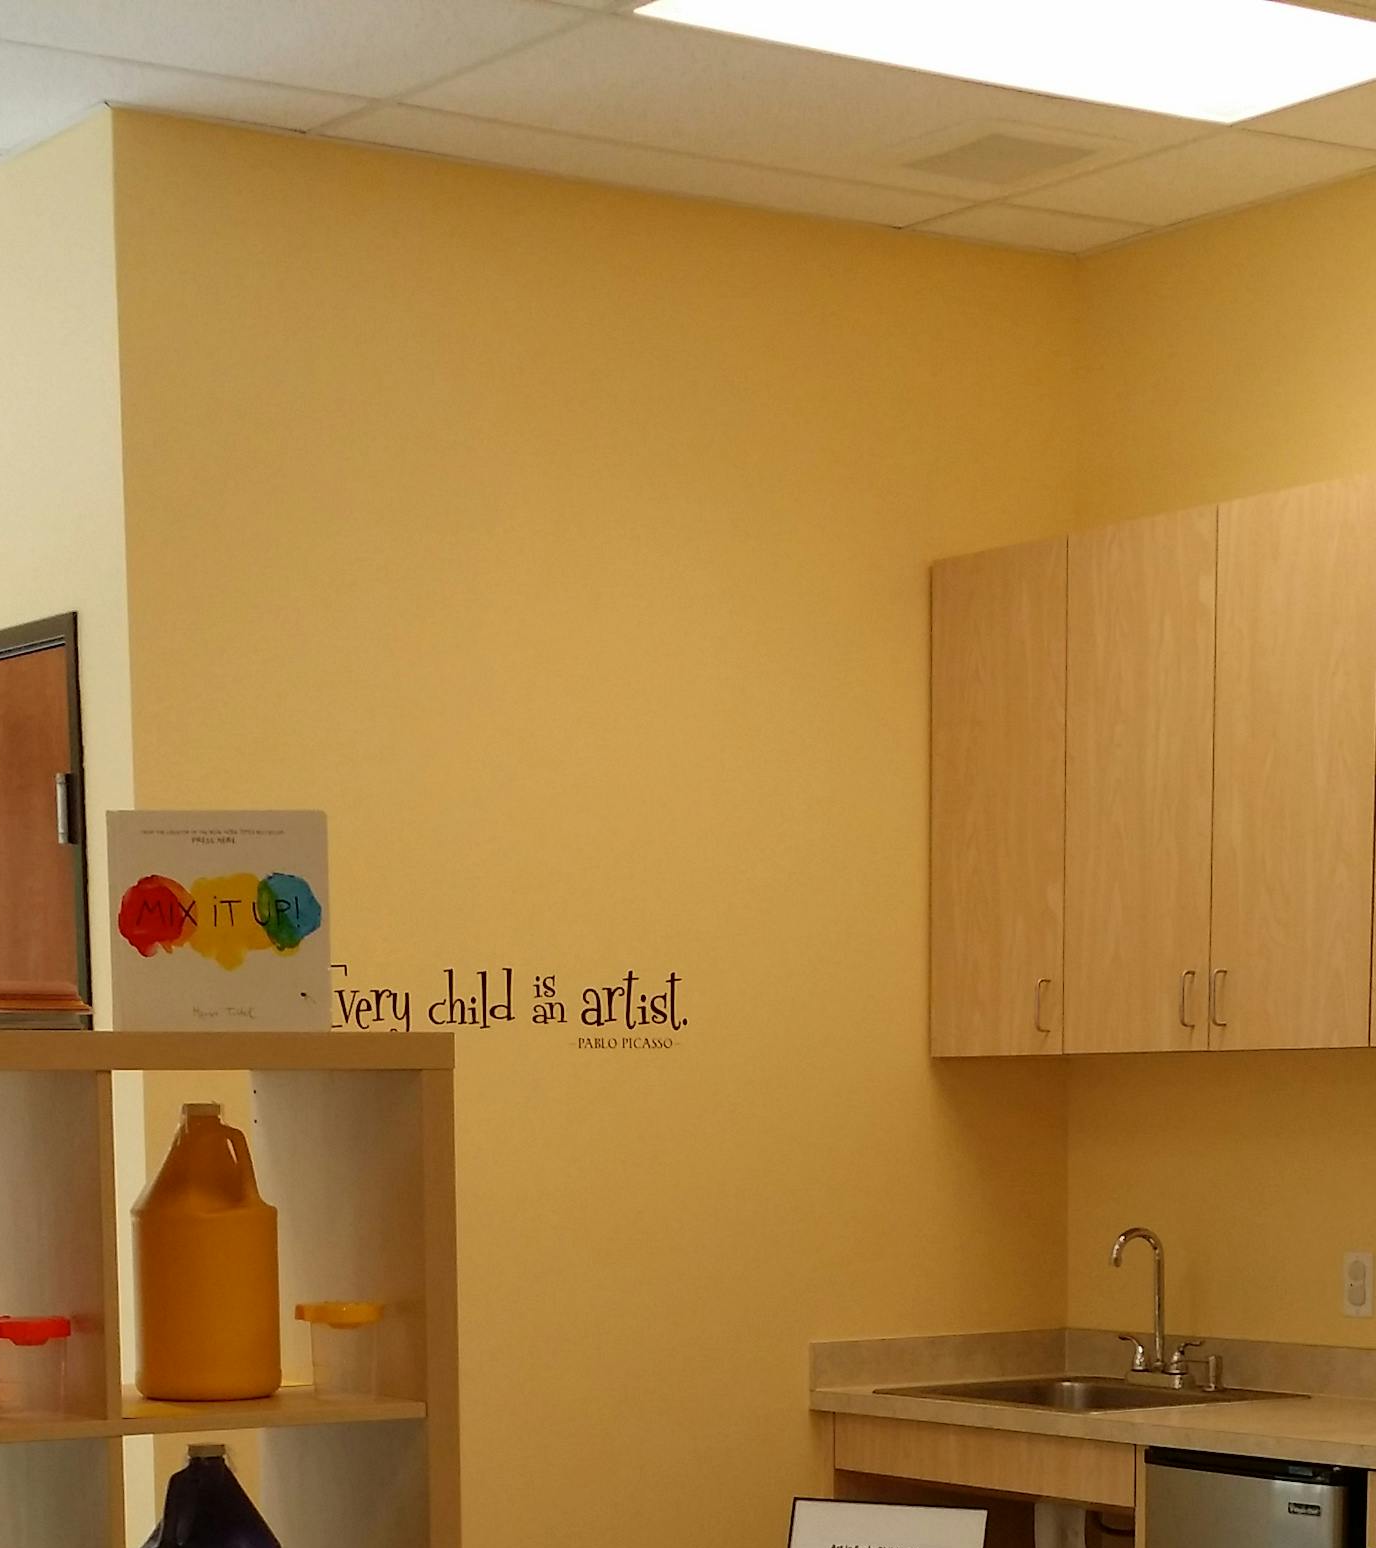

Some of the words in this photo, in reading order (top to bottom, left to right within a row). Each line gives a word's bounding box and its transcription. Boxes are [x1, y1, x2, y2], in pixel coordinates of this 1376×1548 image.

[136, 899, 198, 927] MIX
[252, 895, 301, 928] UP!
[428, 968, 516, 1029] child
[533, 975, 556, 998] is
[580, 970, 689, 1031] artist.
[531, 1001, 568, 1025] an
[578, 1037, 618, 1049] PABLO
[622, 1037, 673, 1049] PICASSO
